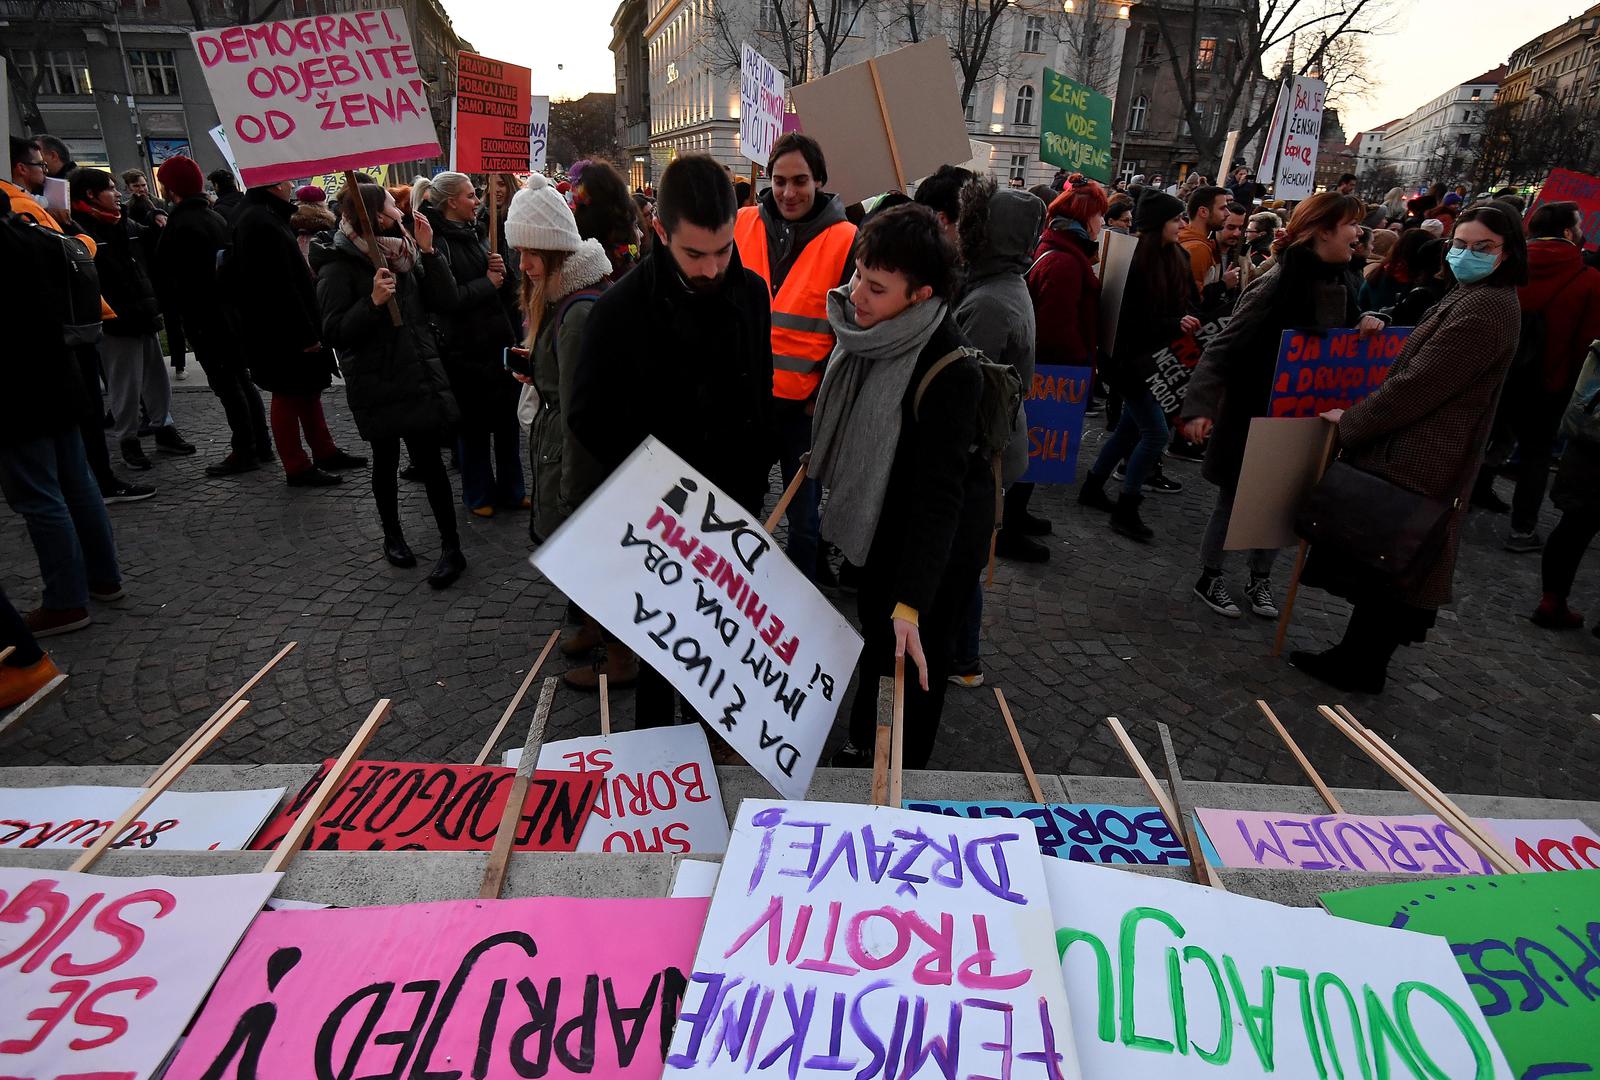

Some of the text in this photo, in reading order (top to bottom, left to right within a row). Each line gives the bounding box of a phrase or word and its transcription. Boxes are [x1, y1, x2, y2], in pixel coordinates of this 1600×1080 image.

[196, 11, 402, 69] DEMOGRAFI,
[459, 58, 502, 77] PRAVO NA
[247, 45, 418, 102] ODJEBITE
[500, 84, 517, 99] NIJE
[1049, 72, 1091, 111] ŽENE
[235, 80, 427, 143] OD ŽENA!
[458, 98, 517, 118] SAMO PRAVNA
[504, 122, 525, 136] NEGO
[1065, 111, 1098, 140] VODE
[482, 139, 529, 154] EKONOMSKA
[1044, 131, 1111, 169] PROMJENE
[1145, 372, 1180, 414] MOJOJ
[620, 522, 683, 586] OBA
[646, 505, 800, 667] FEMINIZMU
[634, 591, 801, 778] DA ŽIVOTA
[741, 637, 808, 722] IMAM
[746, 807, 1029, 906] DRŽAVE!
[723, 895, 1033, 990] PROTIV
[0, 976, 158, 1055] SE
[1055, 906, 1497, 1080] OVULACIJU
